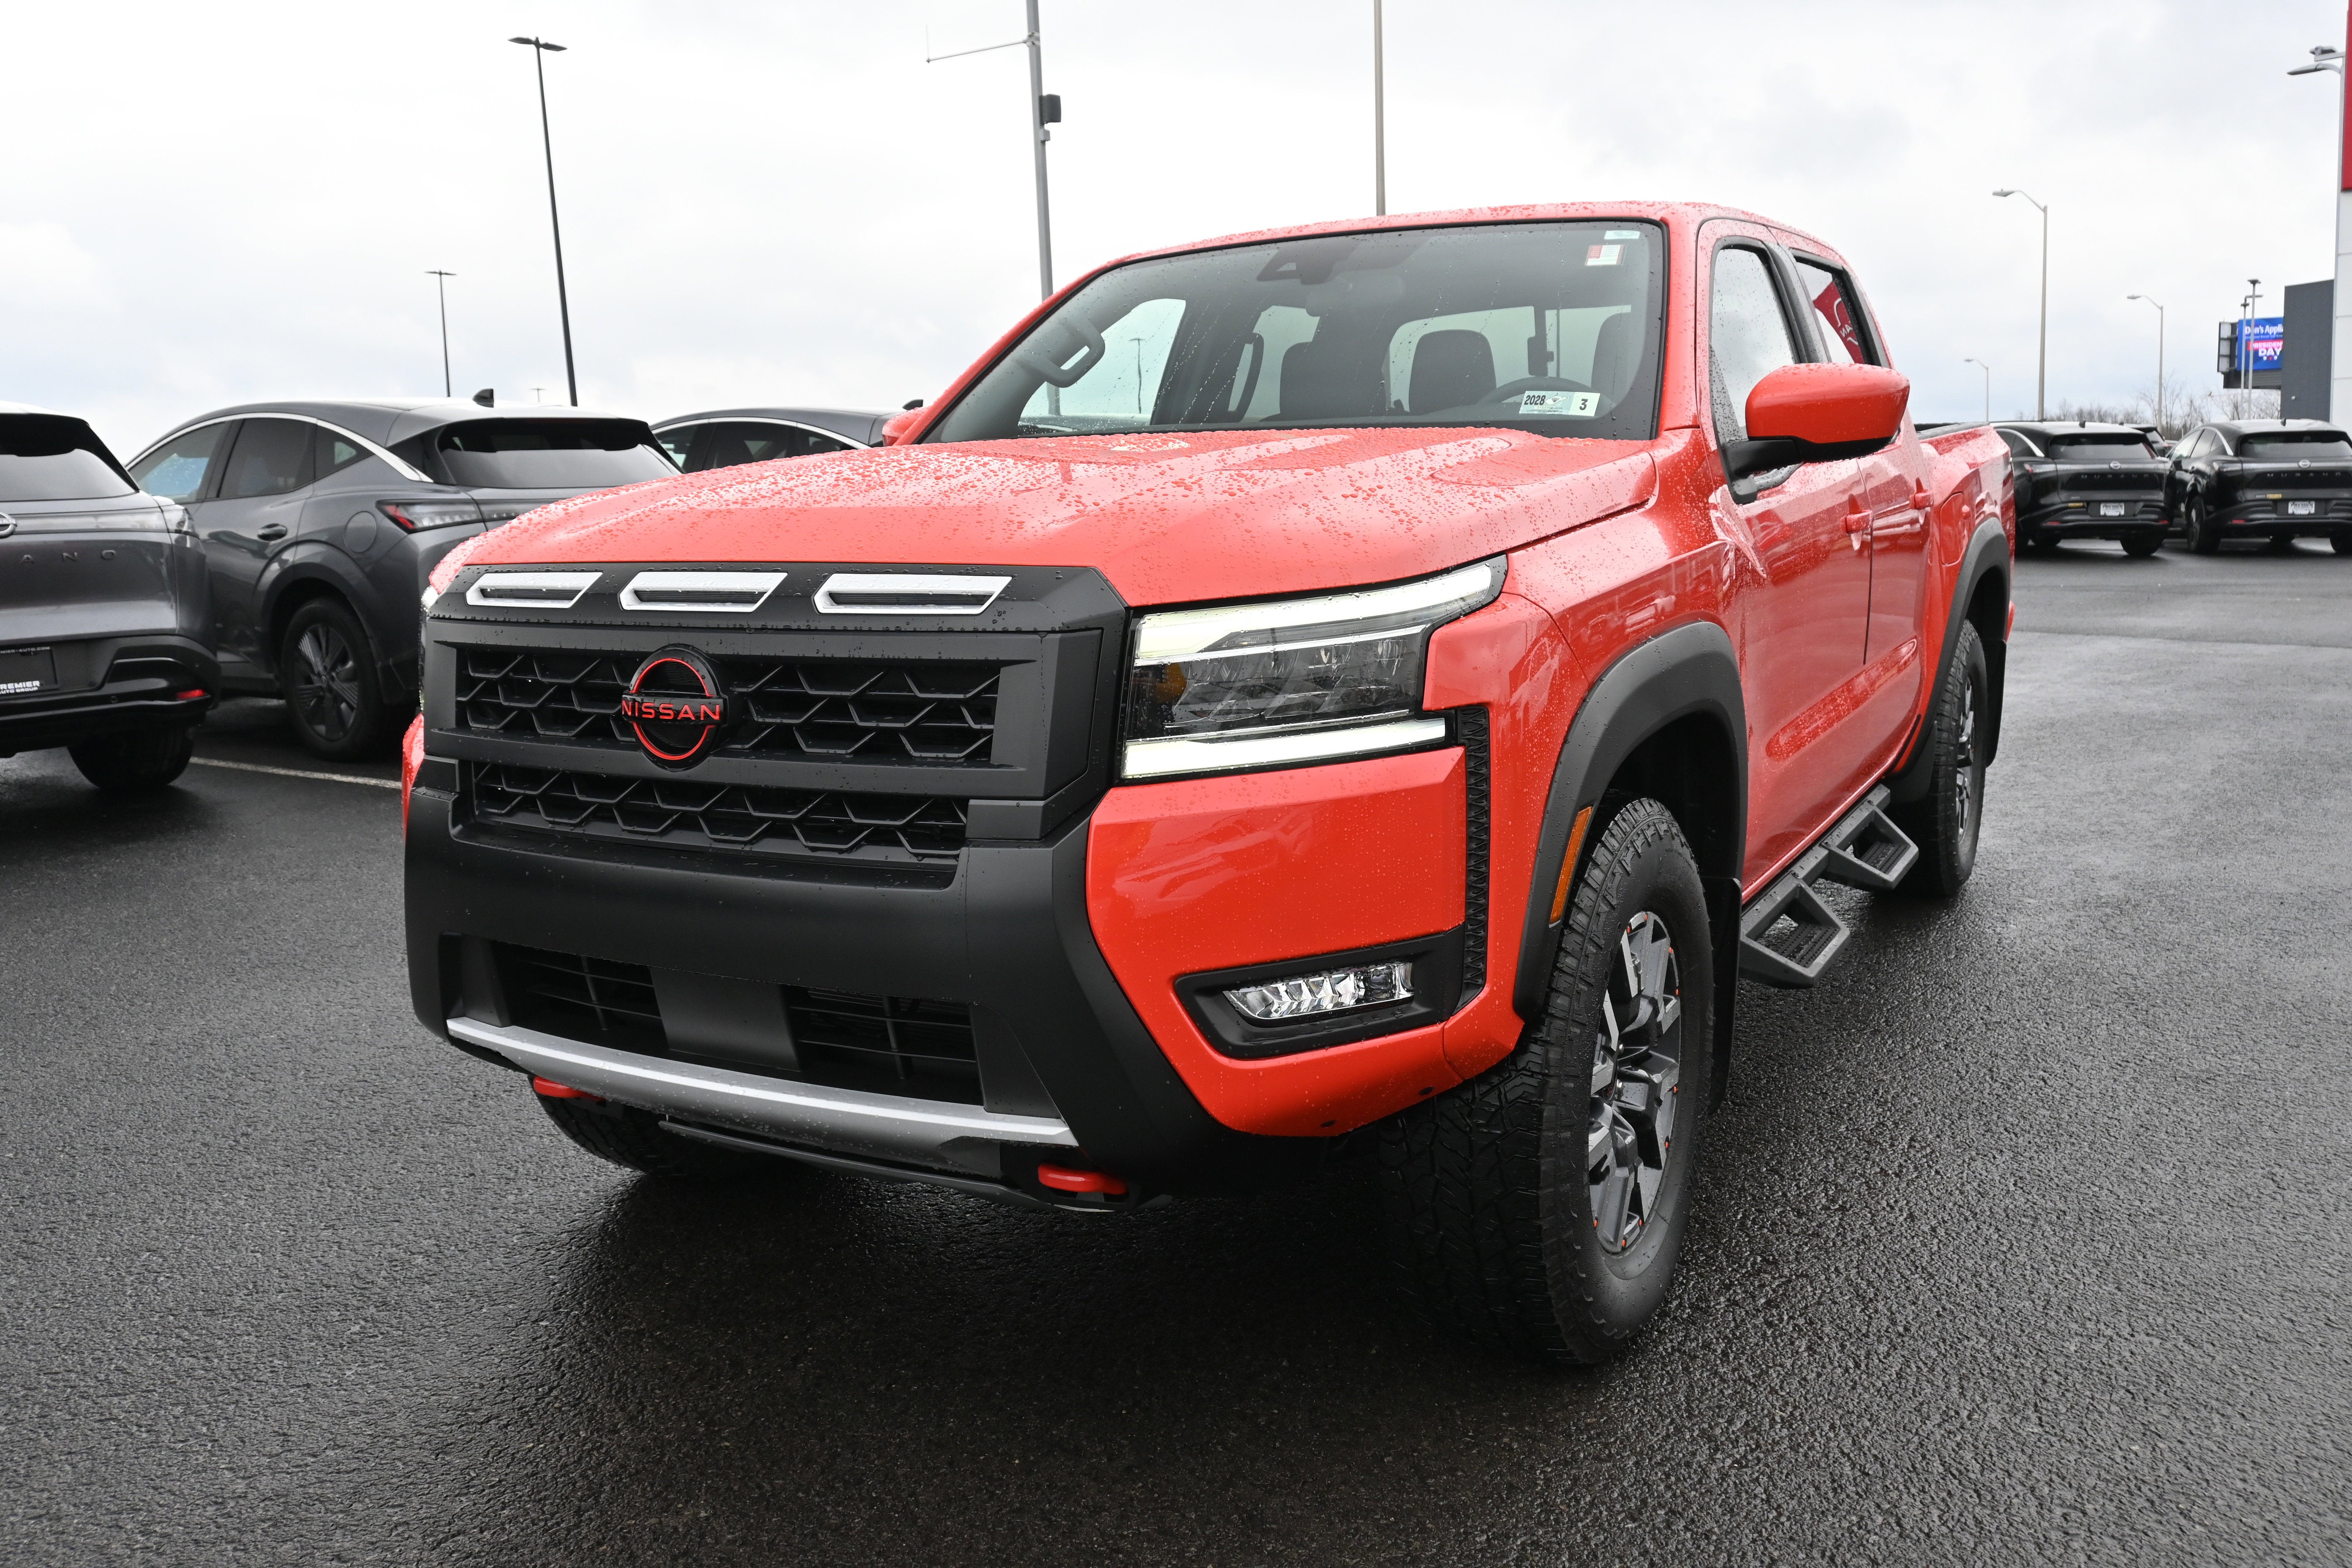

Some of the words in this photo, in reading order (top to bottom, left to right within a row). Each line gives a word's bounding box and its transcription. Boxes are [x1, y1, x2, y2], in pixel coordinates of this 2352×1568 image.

[2245, 325, 2264, 335] Dn's
[2252, 340, 2283, 350] RESIDEN
[2258, 347, 2282, 357] DAY
[1524, 395, 1546, 406] 2028
[1579, 398, 1588, 411] 3
[621, 700, 720, 721] NISSAN
